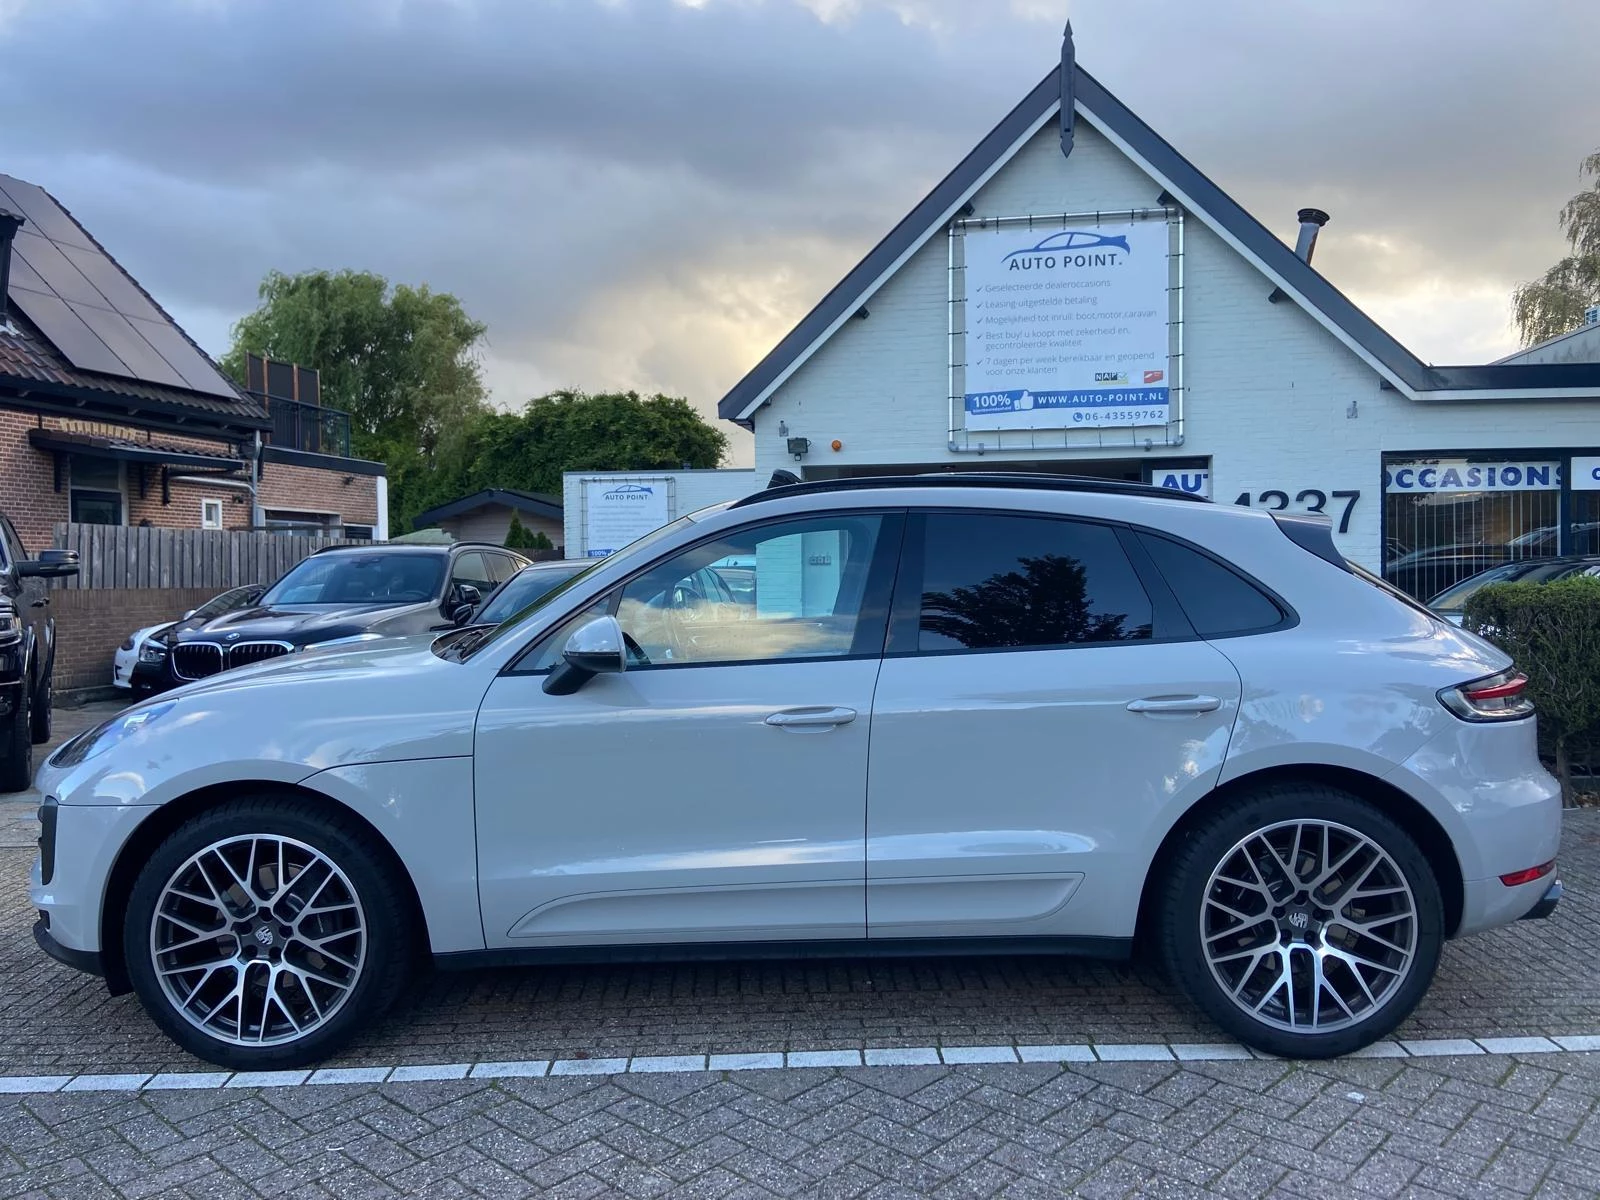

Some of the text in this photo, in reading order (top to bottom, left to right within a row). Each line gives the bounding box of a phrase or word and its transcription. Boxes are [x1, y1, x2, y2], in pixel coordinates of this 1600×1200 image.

[1008, 256, 1056, 271] AUTO
[985, 280, 1111, 293] Geselecteerde dealeroccasions
[1064, 296, 1098, 306] betaling
[985, 331, 1003, 340] Best
[1031, 328, 1055, 339] koopt
[985, 339, 1047, 352] gecontroleerde
[993, 356, 1018, 367] dagen
[1117, 351, 1155, 363] geopend
[985, 368, 1003, 376] voor
[1027, 365, 1058, 374] klanten
[973, 393, 1011, 408] 100%
[1037, 392, 1164, 404] WWW.AUTO-POINT.NL
[1084, 410, 1164, 421] 06-43559762
[1162, 473, 1208, 493] AU
